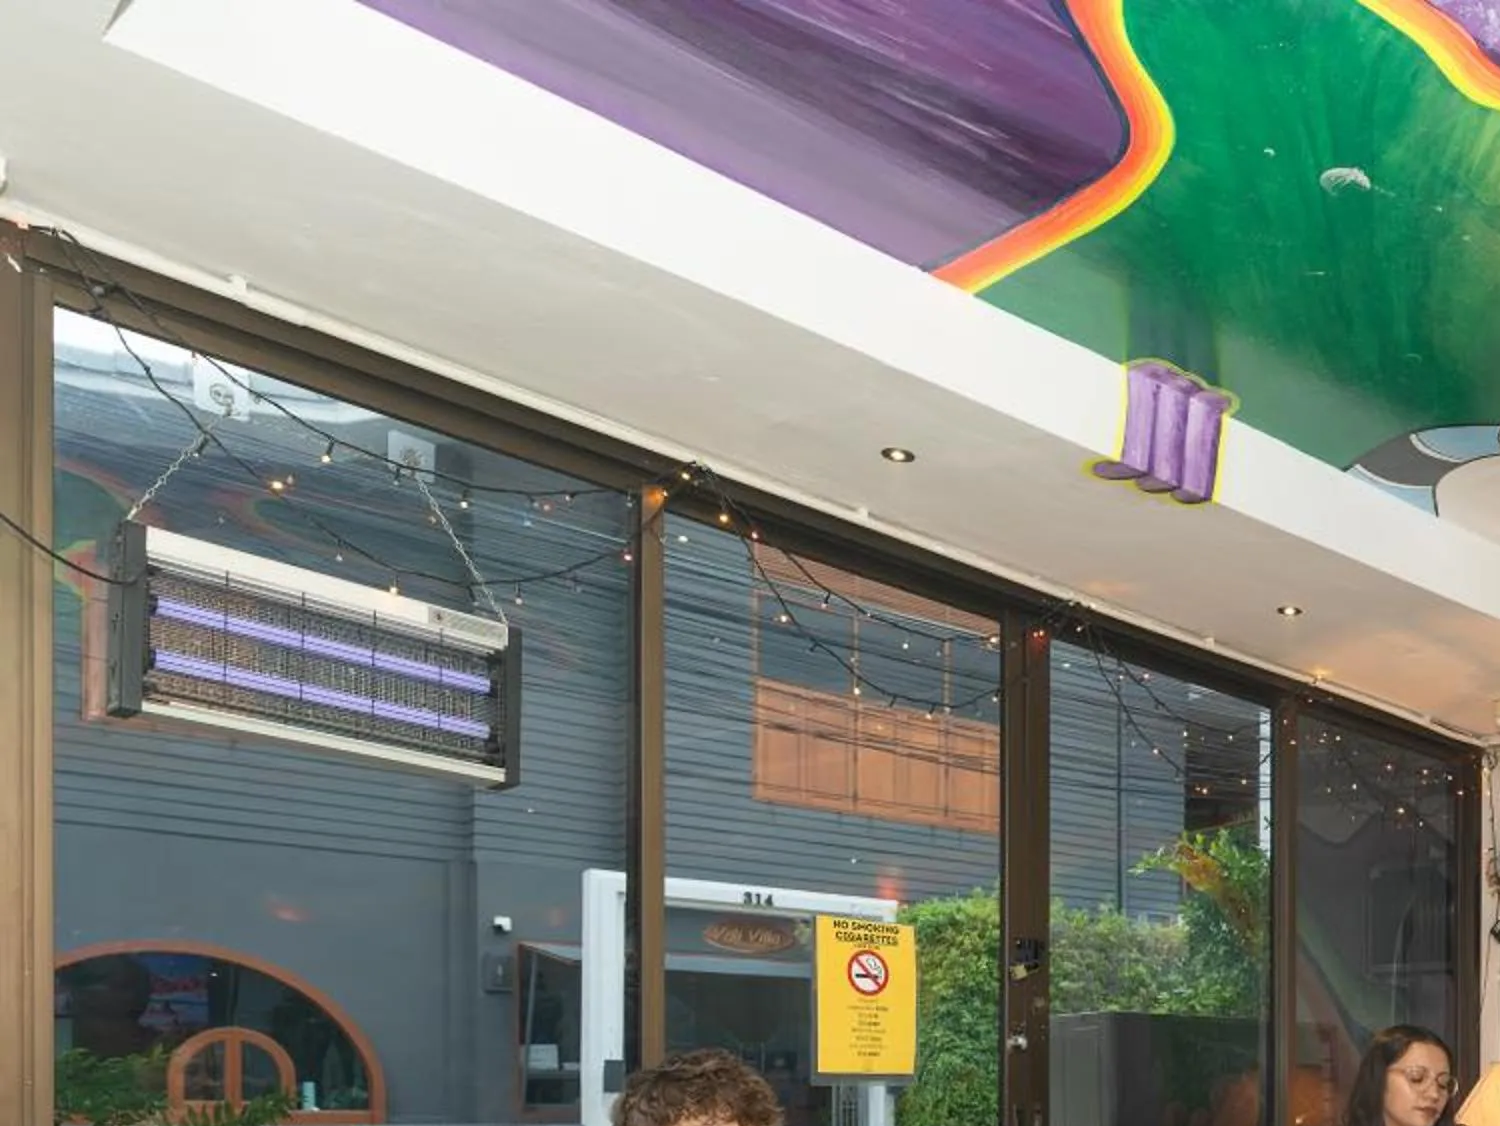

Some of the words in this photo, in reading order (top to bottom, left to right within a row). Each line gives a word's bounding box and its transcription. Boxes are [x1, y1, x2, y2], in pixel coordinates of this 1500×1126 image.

[743, 891, 773, 907] 314
[833, 919, 849, 929] NO
[851, 921, 900, 935] SMOKING
[835, 931, 898, 946] CIGARETTES
